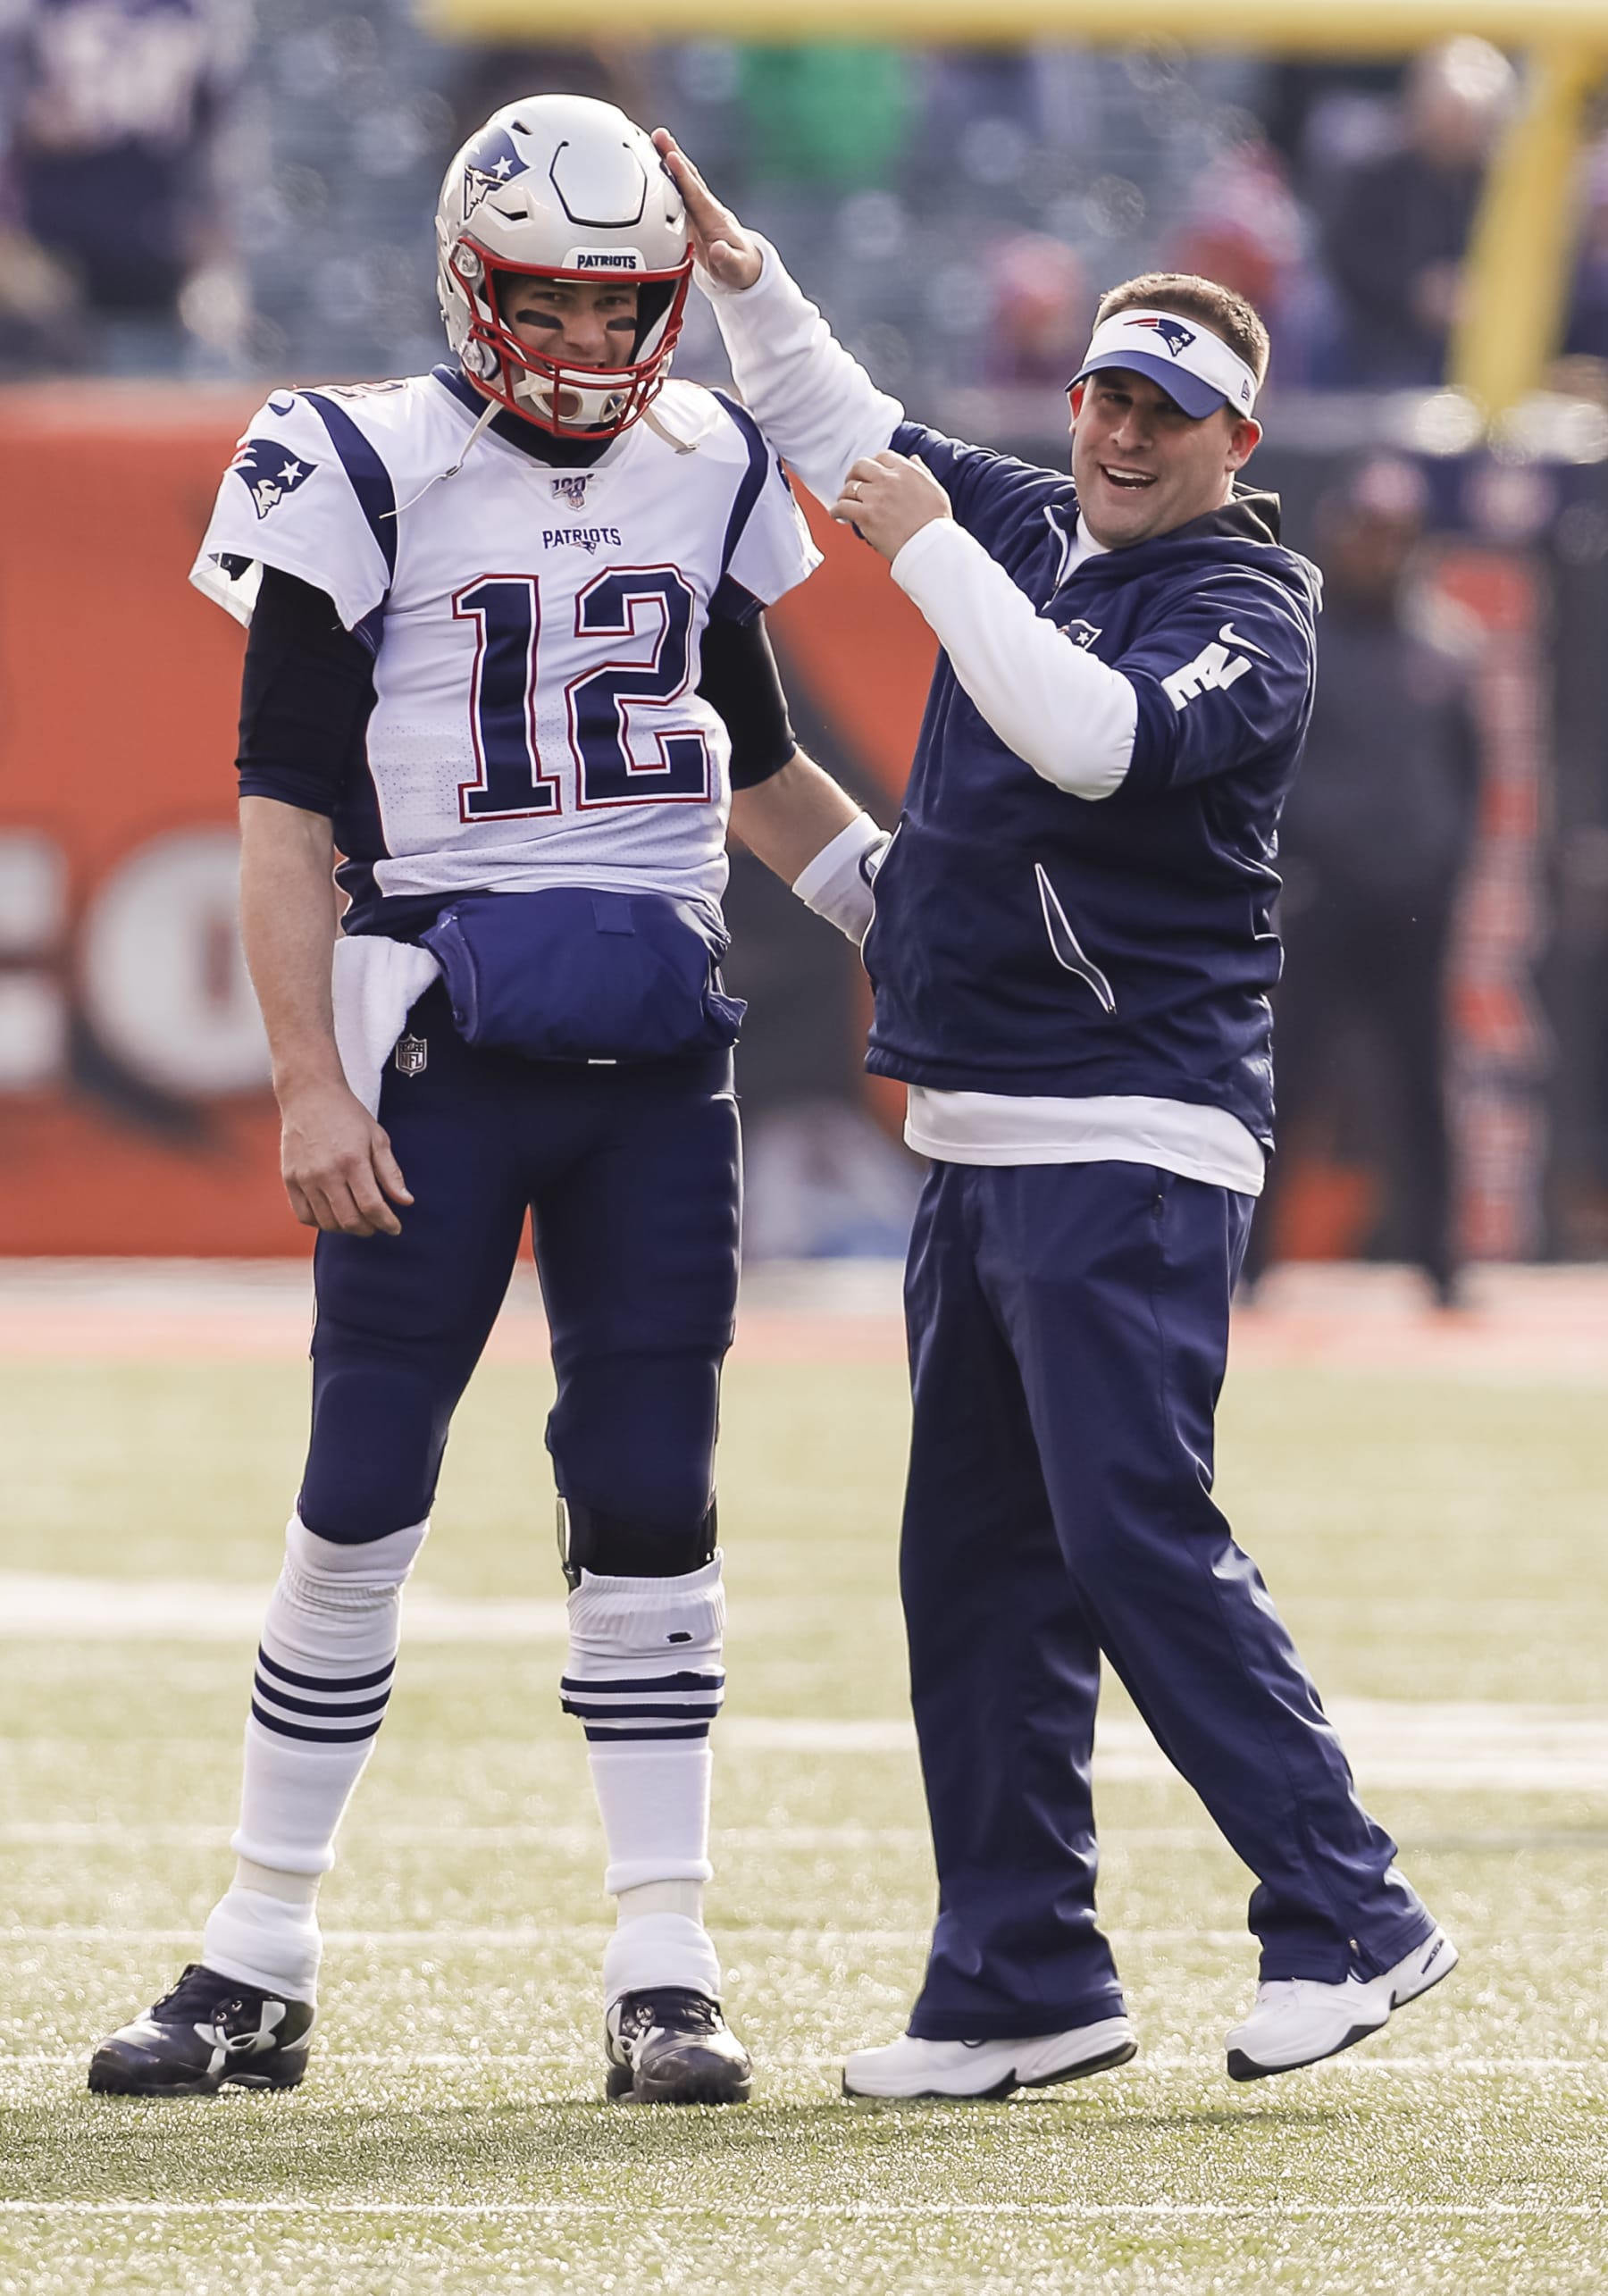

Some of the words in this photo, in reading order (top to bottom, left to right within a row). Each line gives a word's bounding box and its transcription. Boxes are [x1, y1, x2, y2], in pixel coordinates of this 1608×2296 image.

[577, 254, 636, 270] PATRIOTS
[542, 527, 622, 549] PATRIOTS
[451, 563, 712, 824] 12
